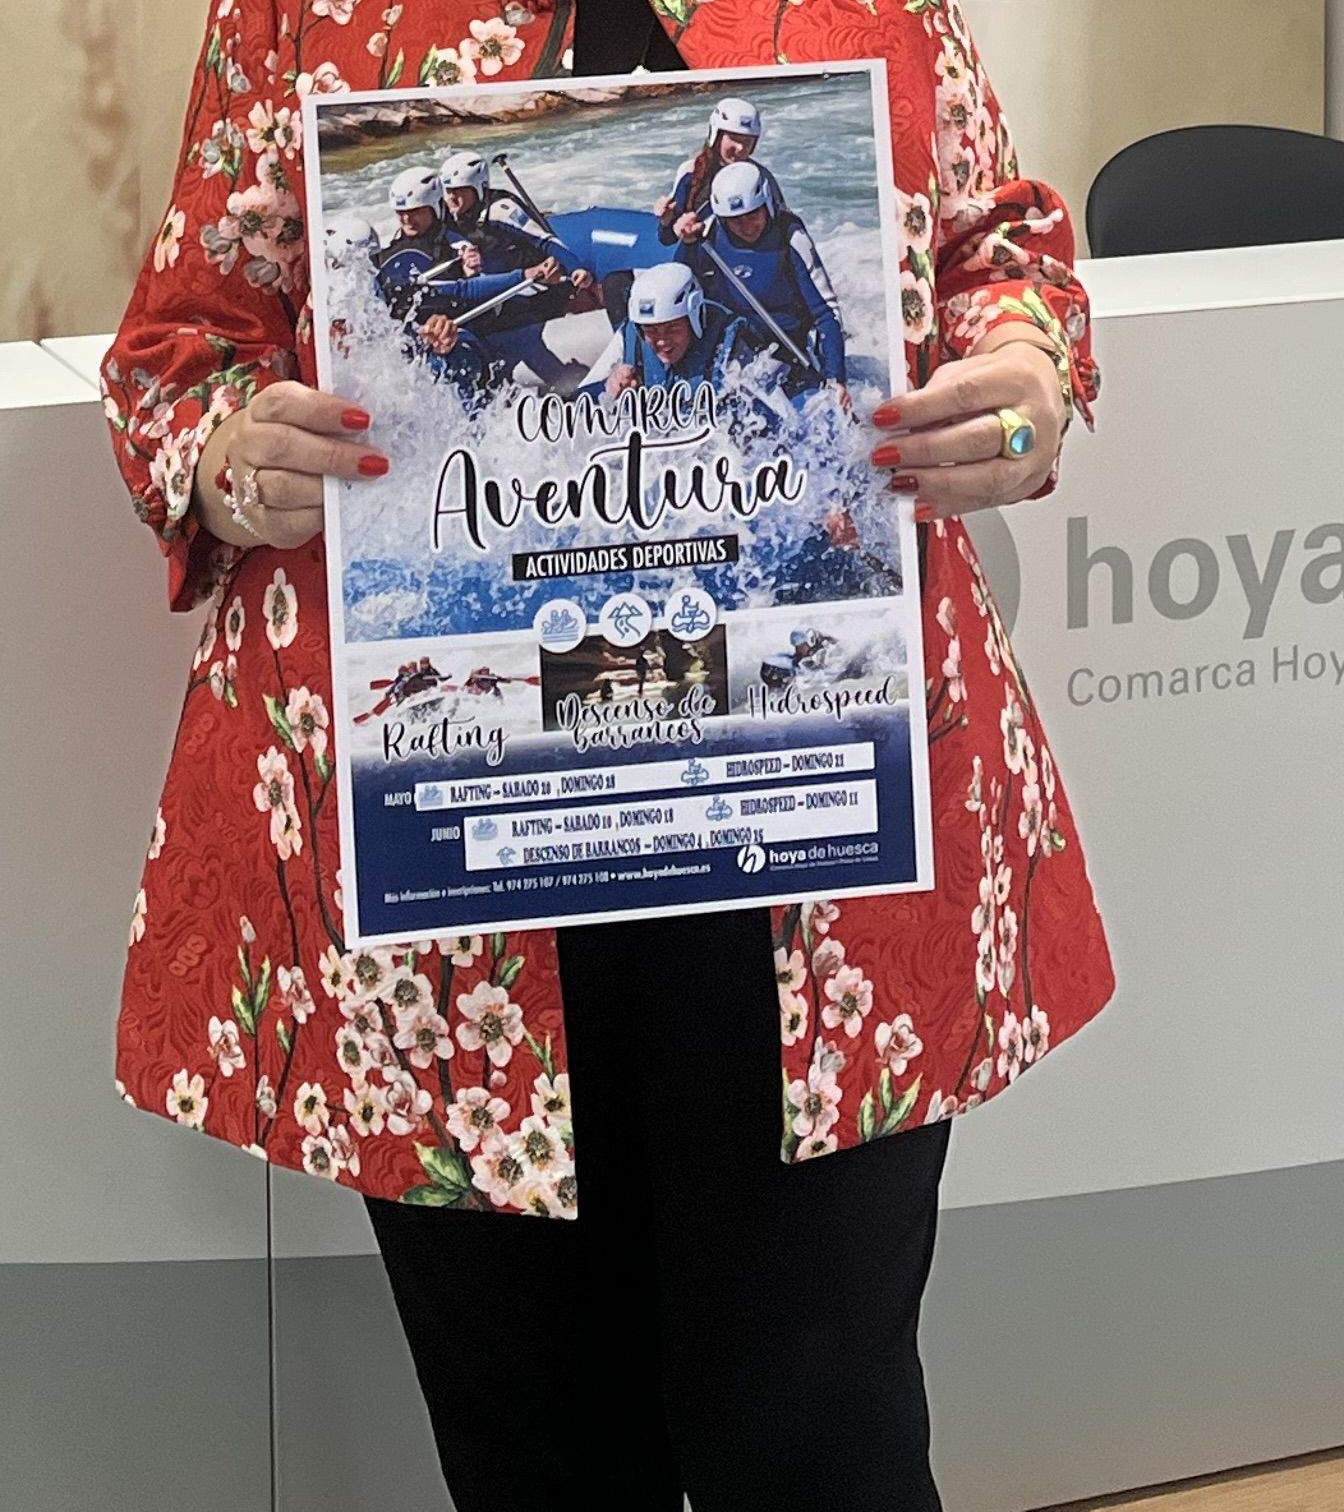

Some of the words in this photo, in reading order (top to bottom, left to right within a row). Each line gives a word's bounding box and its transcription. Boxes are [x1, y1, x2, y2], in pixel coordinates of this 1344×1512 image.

[430, 428, 805, 551] Aventura
[525, 547, 628, 579] ACTIVIDADES
[632, 539, 727, 571] DEPORTIVAS
[747, 677, 898, 720] Hidrospeed
[1067, 659, 1257, 707] Comarca
[556, 693, 674, 730] Descenso
[679, 684, 716, 717] de
[383, 717, 507, 764] Rafting
[792, 752, 834, 772] DOMINGO
[451, 784, 492, 804] RAFTING
[806, 790, 848, 810] DOMINGO
[512, 817, 553, 837] RAFTING
[523, 843, 570, 864] DESCENSO
[572, 842, 584, 860] DE
[586, 837, 641, 858] BARRANCOS
[653, 831, 695, 852] DOMINGO
[769, 848, 806, 864] hoya
[808, 845, 826, 860] de
[827, 841, 879, 858] huesca
